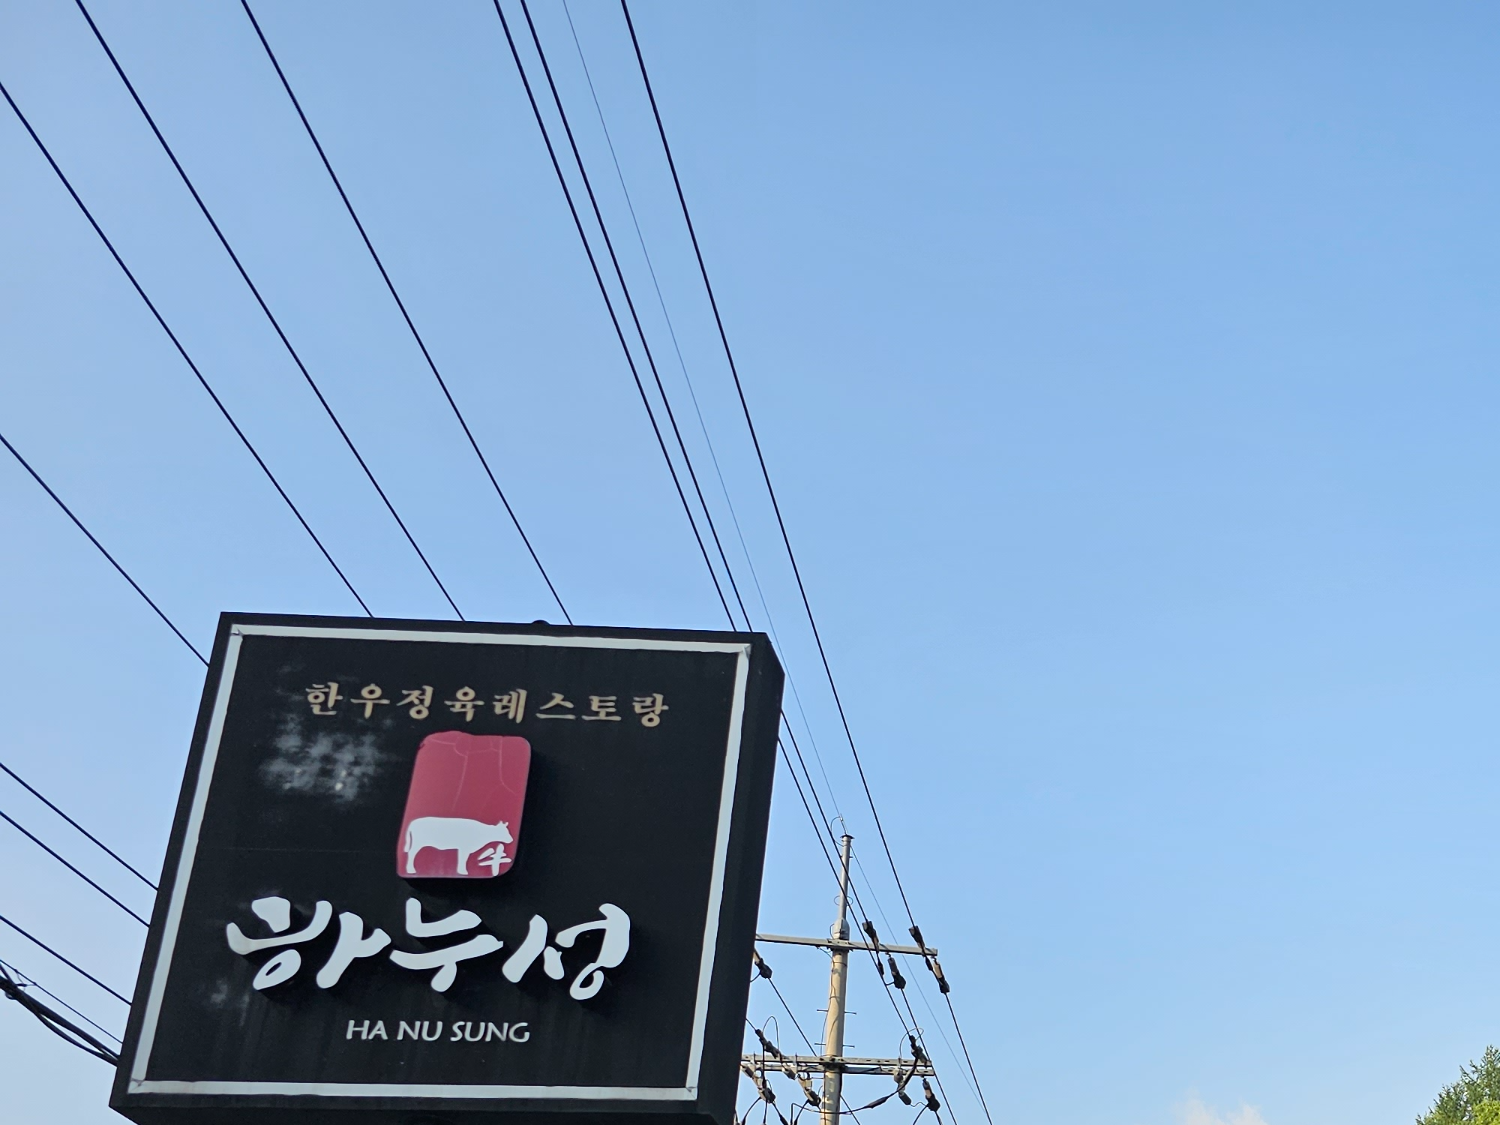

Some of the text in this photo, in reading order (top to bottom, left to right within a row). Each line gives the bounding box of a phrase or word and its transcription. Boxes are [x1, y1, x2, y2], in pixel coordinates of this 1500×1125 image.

[305, 682, 669, 727] 한우정육레스토랑
[226, 896, 630, 1000] 하누성
[346, 1020, 530, 1042] HA NU SUNG
